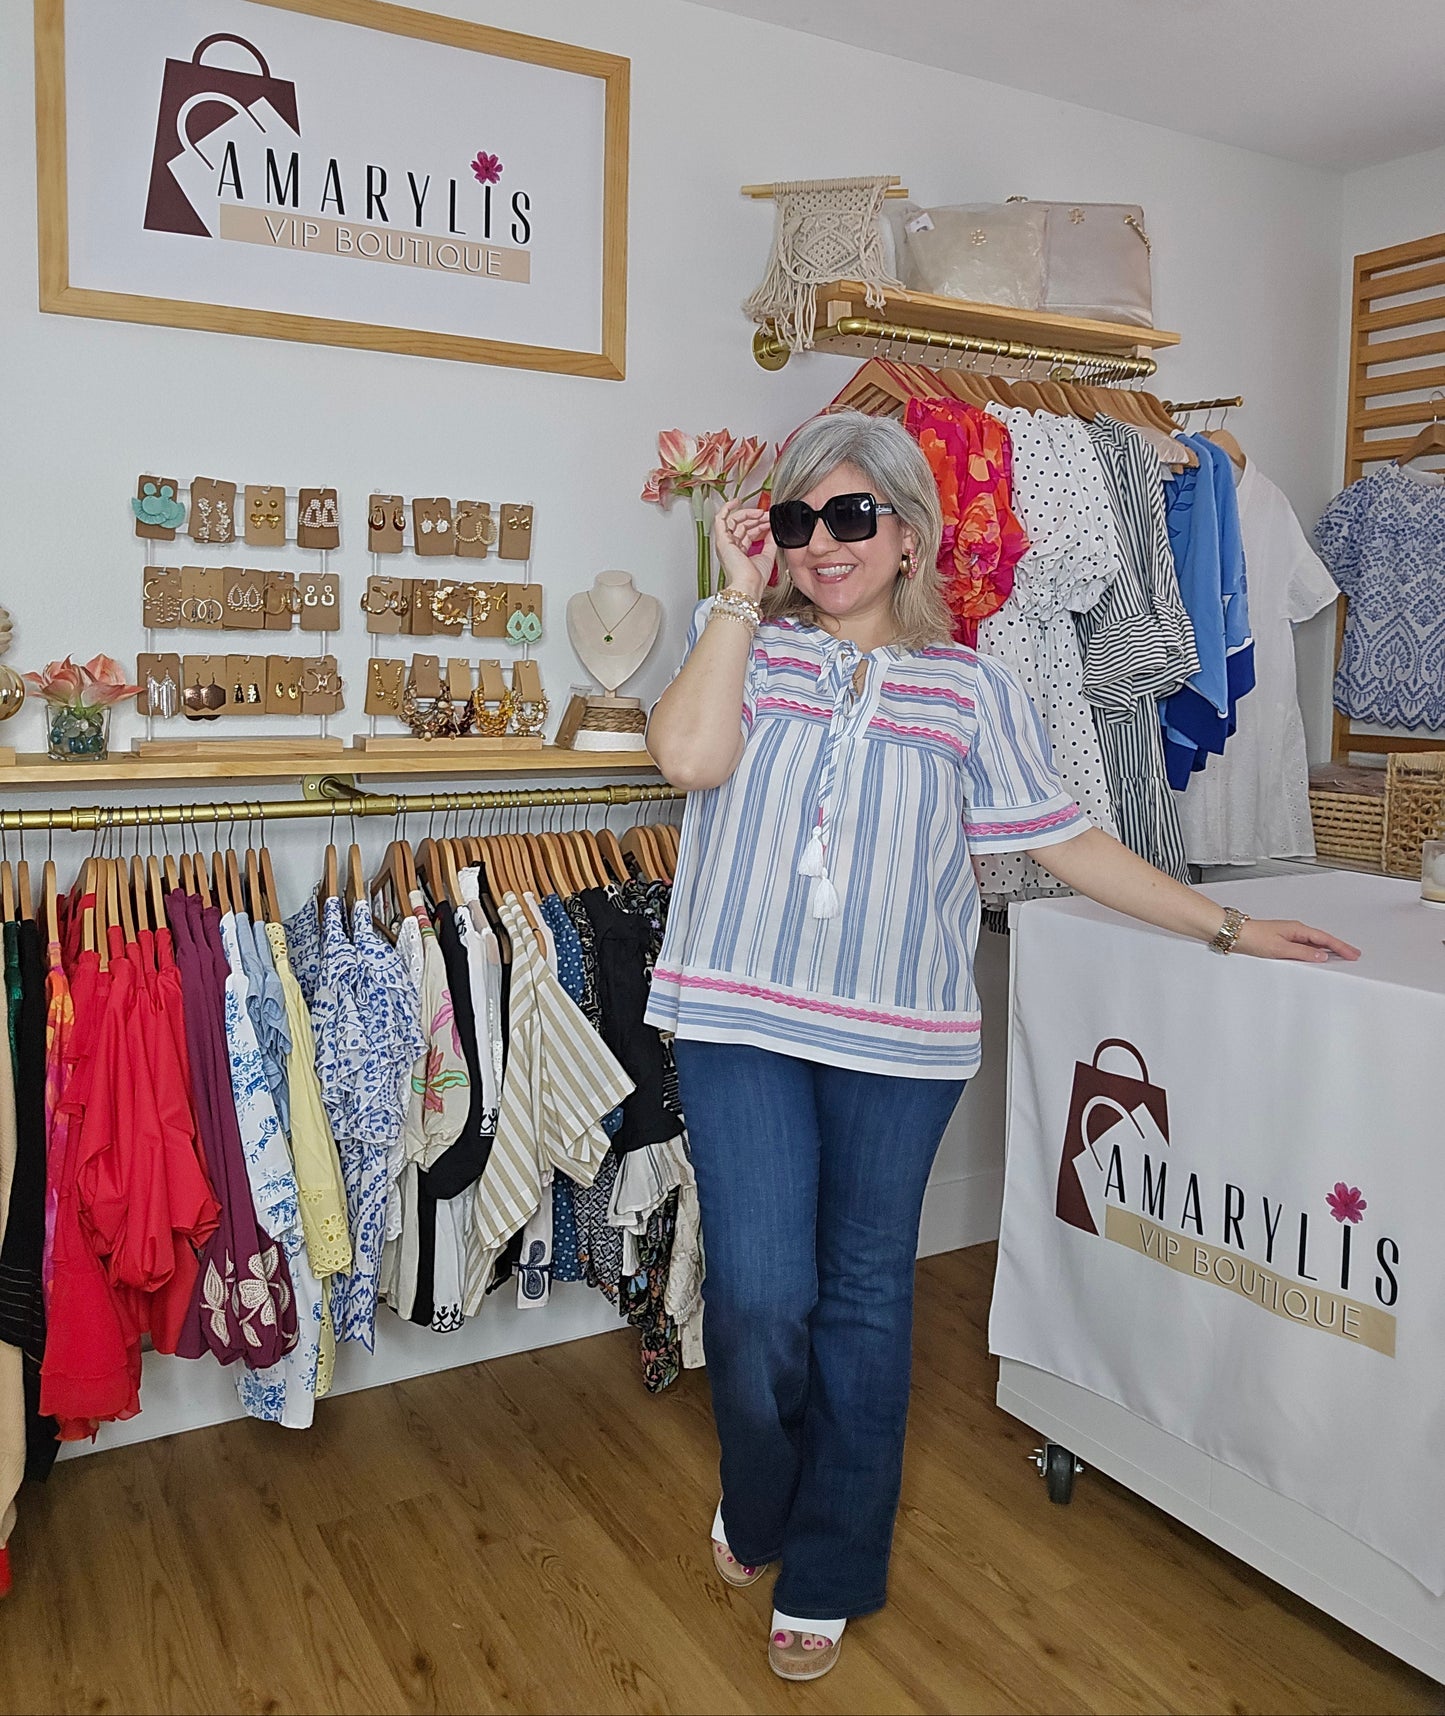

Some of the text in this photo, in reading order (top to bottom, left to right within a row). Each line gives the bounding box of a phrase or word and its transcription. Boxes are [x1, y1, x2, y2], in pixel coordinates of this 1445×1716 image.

[217, 141, 531, 244] AMARYLIS
[264, 216, 502, 277] VIP BOUTIQUE
[1104, 1144, 1400, 1307] AMARYLIS
[1140, 1223, 1362, 1339] VIP BOUTIQUE
